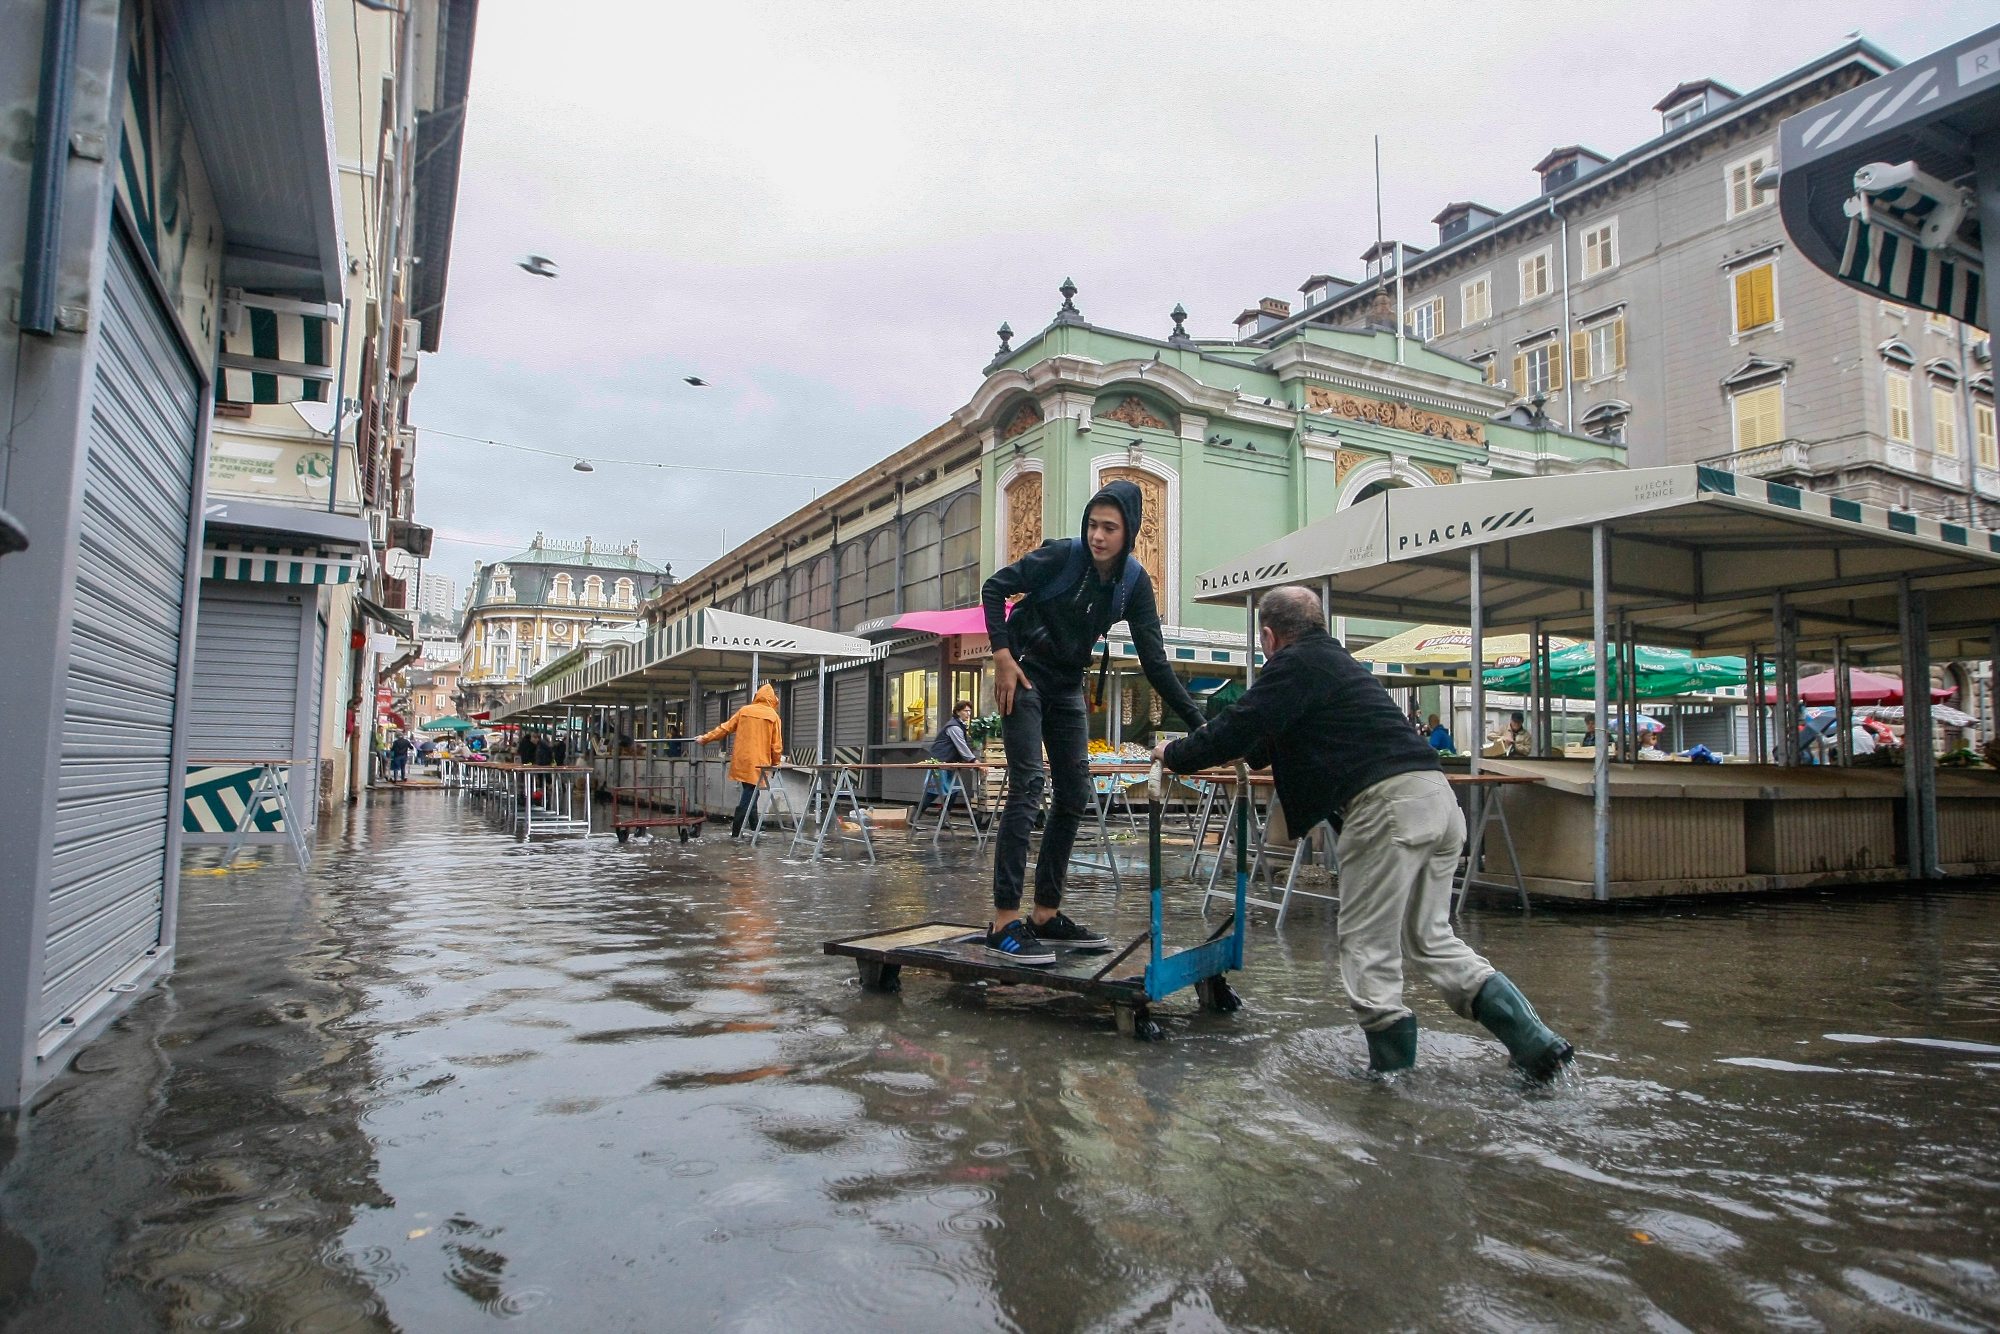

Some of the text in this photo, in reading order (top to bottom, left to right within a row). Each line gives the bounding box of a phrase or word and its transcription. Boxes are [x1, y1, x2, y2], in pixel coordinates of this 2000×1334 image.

[1635, 488, 1674, 501] TRŽNICE
[1400, 521, 1473, 550] PLACA
[1202, 570, 1250, 590] PLACA
[711, 636, 761, 646] PLACA
[963, 646, 982, 656] PLACA
